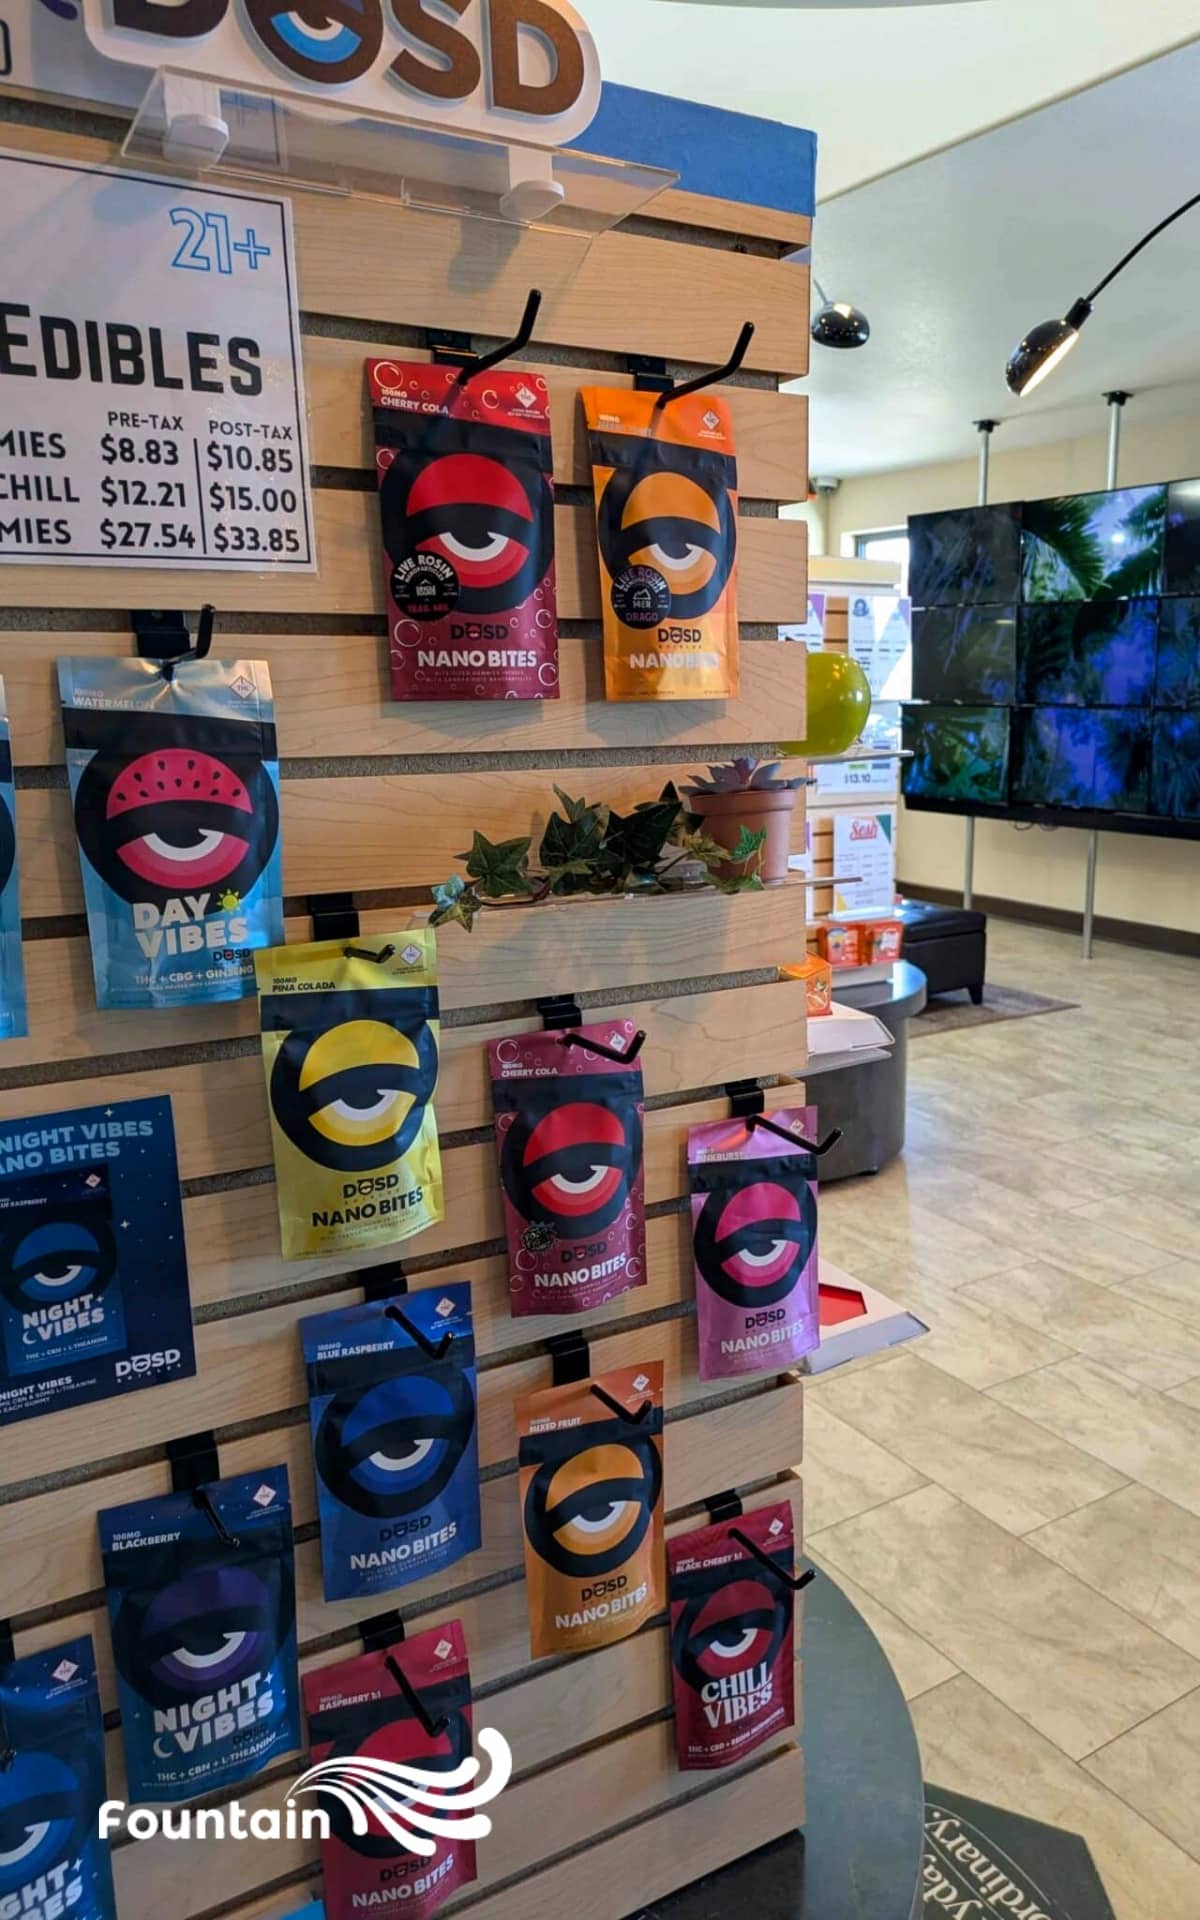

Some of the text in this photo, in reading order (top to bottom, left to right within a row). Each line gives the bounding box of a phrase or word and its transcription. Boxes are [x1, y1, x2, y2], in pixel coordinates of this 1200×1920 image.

[169, 208, 270, 274] 21+
[0, 303, 262, 396] EDIBLES
[381, 396, 448, 414] CHERRY COLA
[108, 411, 293, 441] PRE-TAX POST-TAX
[101, 434, 179, 465] $8.83
[207, 441, 293, 473] $10.85
[101, 476, 186, 507] $12.21
[210, 483, 296, 513] $15.00
[101, 519, 195, 549] $27.54
[214, 523, 300, 552] $33.85
[394, 554, 453, 581] LIVE ROSIN
[418, 650, 537, 667] NANO BITES
[133, 893, 211, 929] DAY
[135, 918, 248, 960] VIBES
[169, 971, 193, 982] CBG
[206, 966, 254, 978] GINSENG
[298, 982, 336, 991] COLADA
[502, 1068, 558, 1078] CHERRY COLA
[0, 1120, 153, 1153] NIGHT VIBES
[50, 1141, 120, 1164] BITES
[312, 1204, 376, 1228] NANO
[380, 1186, 423, 1215] BITES
[534, 1268, 590, 1288] NANO
[592, 1252, 626, 1280] BITES
[22, 1293, 94, 1329] NIGHT
[37, 1308, 105, 1340] VIBES
[317, 1341, 394, 1360] BLUE RASPBERRY
[721, 1319, 804, 1354] NANO BITES
[0, 1376, 72, 1400] NIGHT VIBES
[558, 1416, 582, 1428] FRUIT
[112, 1532, 181, 1552] BLACKBERRY
[351, 1544, 410, 1570] NANO
[412, 1522, 456, 1554] BITES
[676, 1560, 701, 1574] BLACK
[703, 1554, 733, 1568] CHERRY
[556, 1582, 647, 1629] NANO BITES
[702, 1662, 773, 1704] CHILL
[154, 1672, 262, 1733] NIGHT
[319, 1694, 369, 1712] RASPBERRY
[704, 1682, 773, 1728] VIBES
[174, 1689, 274, 1754] VIBES
[157, 1771, 176, 1782] THC
[188, 1762, 210, 1776] CBN
[352, 1884, 412, 1908] NANO
[414, 1854, 454, 1895] BITES
